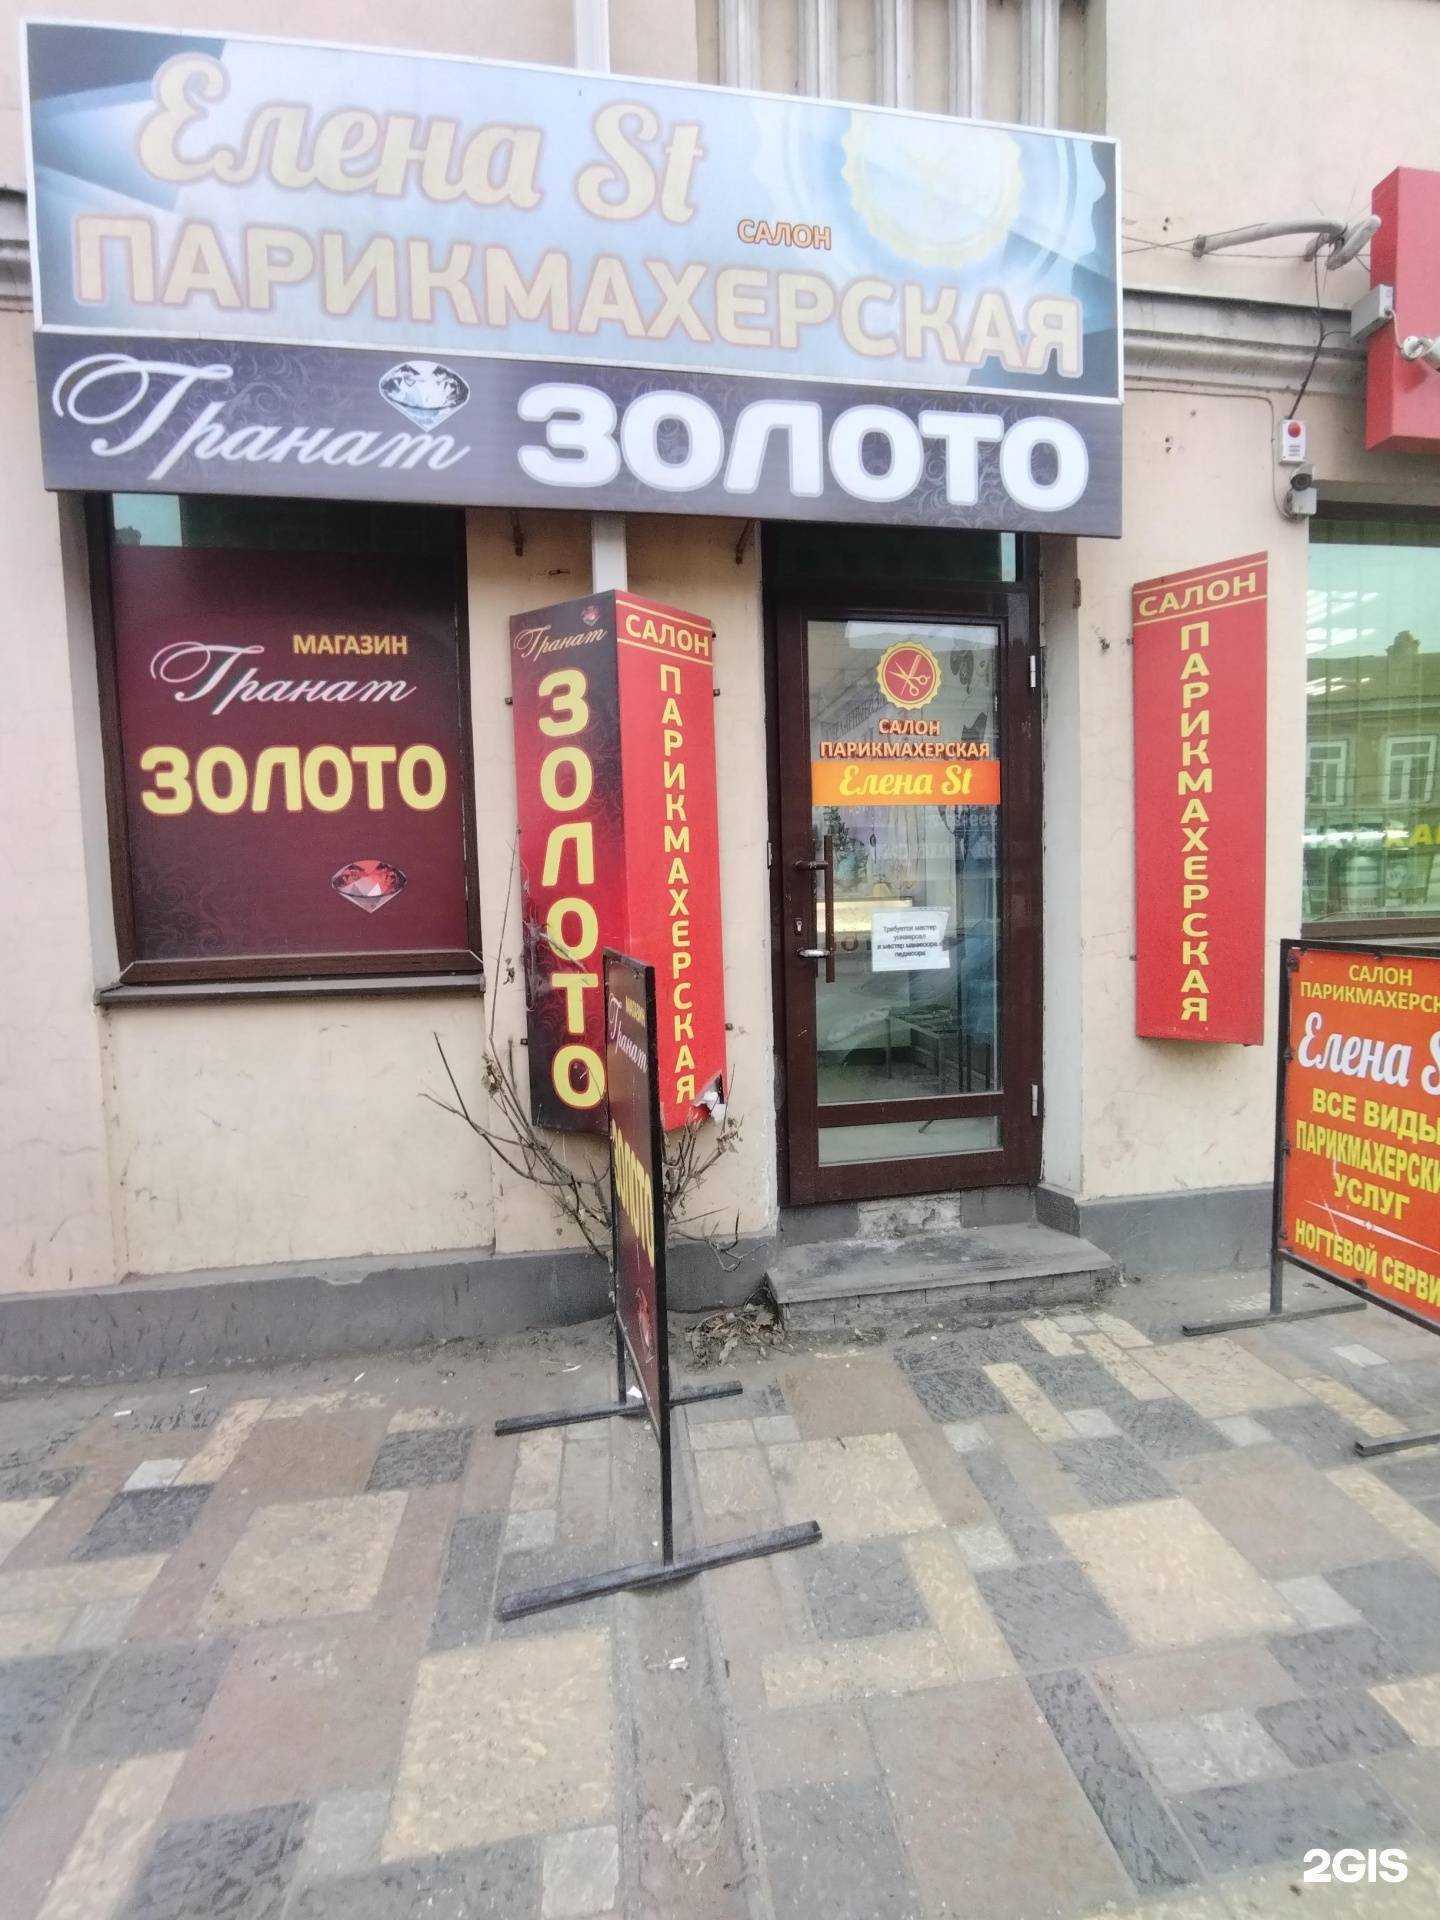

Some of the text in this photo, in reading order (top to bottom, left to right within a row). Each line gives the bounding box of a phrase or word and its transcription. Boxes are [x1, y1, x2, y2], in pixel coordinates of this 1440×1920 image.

[136, 53, 704, 225] Елена St
[737, 218, 832, 250] САЛОН
[73, 213, 1084, 379] ПАРИКМАХЕРСКАЯ
[52, 353, 1090, 512] Гранат ЗОЛОТО
[1138, 572, 1257, 617] САЛОН
[293, 634, 408, 656] МАГАЗИН
[513, 624, 609, 662] Гранат
[625, 613, 710, 657] САЛОН
[151, 641, 417, 715] Гранат
[820, 740, 990, 760] ПАРИКМАХЕРСКАЯ
[879, 718, 941, 736] САЛОН
[140, 744, 448, 815] ЗОЛОТО
[839, 764, 974, 797] Елена St
[1177, 620, 1213, 1022] ПАРИКМАХЕРСКАЯ
[538, 668, 606, 1108] ЗОЛОТО
[659, 663, 696, 1105] ПАРИКМАХЕРСКАЯ
[1349, 964, 1413, 986] САЛОН
[1298, 1011, 1413, 1088] Елена
[1312, 1087, 1440, 1145] ВСЕ ВИДЫ
[1333, 1171, 1411, 1221] УСЛУГ
[1295, 1217, 1378, 1279] НОГТЕВОЙ
